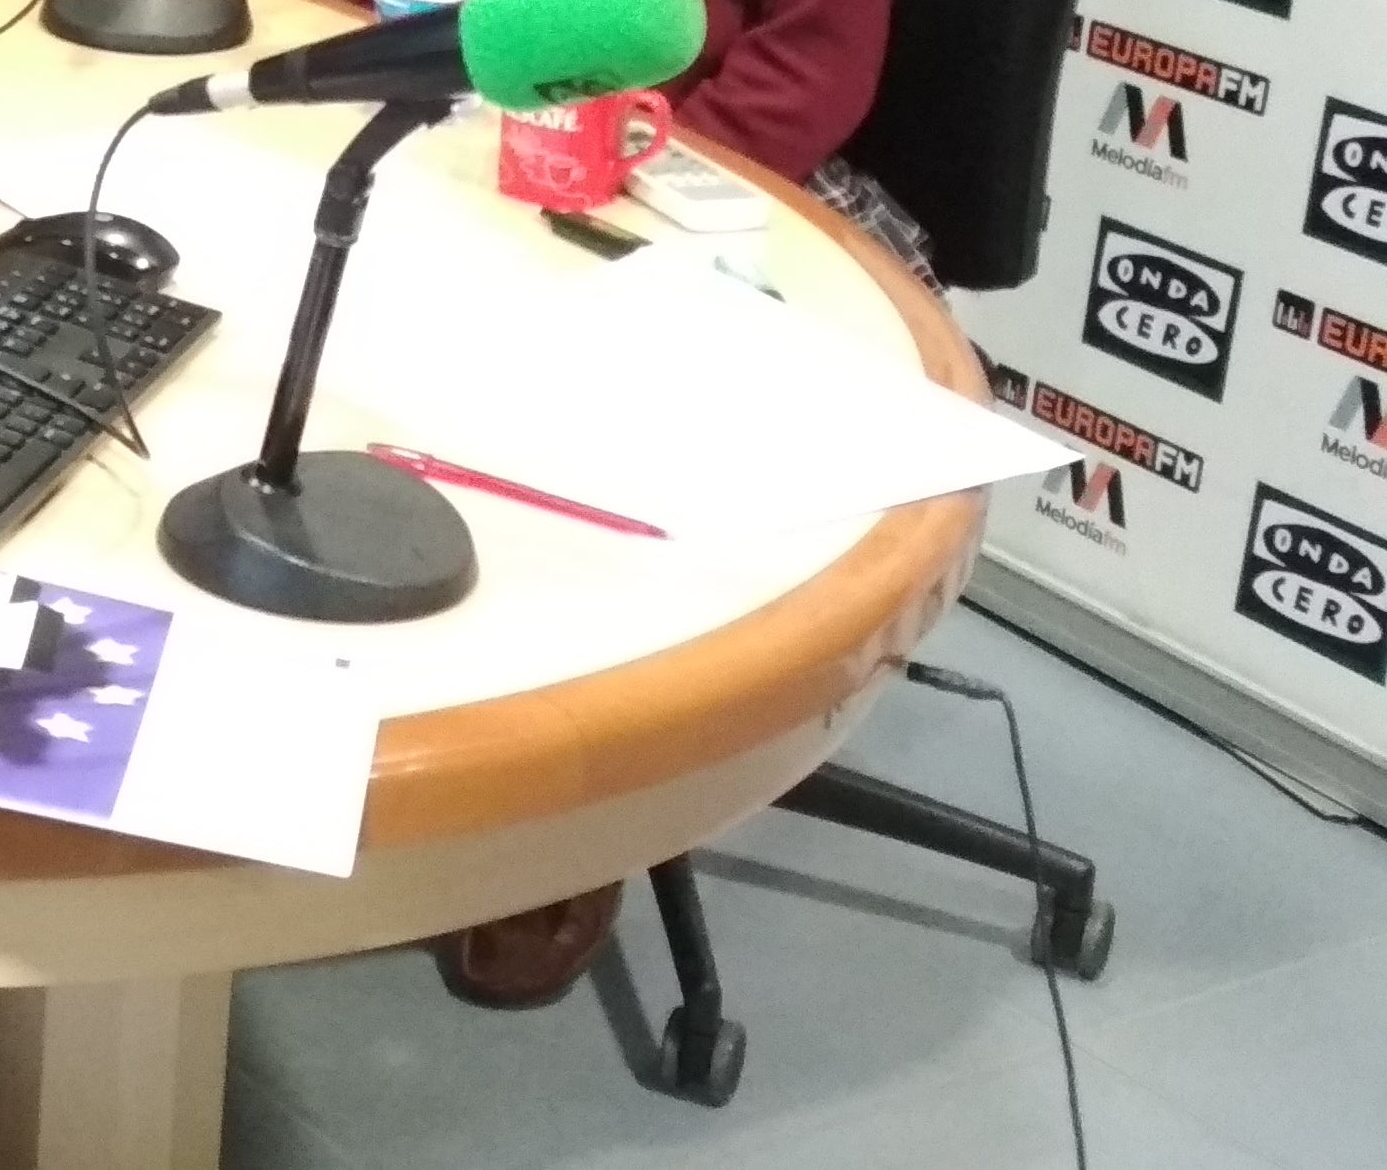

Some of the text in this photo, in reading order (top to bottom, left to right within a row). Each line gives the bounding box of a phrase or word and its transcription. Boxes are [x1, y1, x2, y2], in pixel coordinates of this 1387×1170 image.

[1116, 258, 1210, 313] ONDA
[1115, 305, 1203, 357] CERO
[1274, 527, 1373, 592] ONDA
[1272, 576, 1366, 636] CERO
